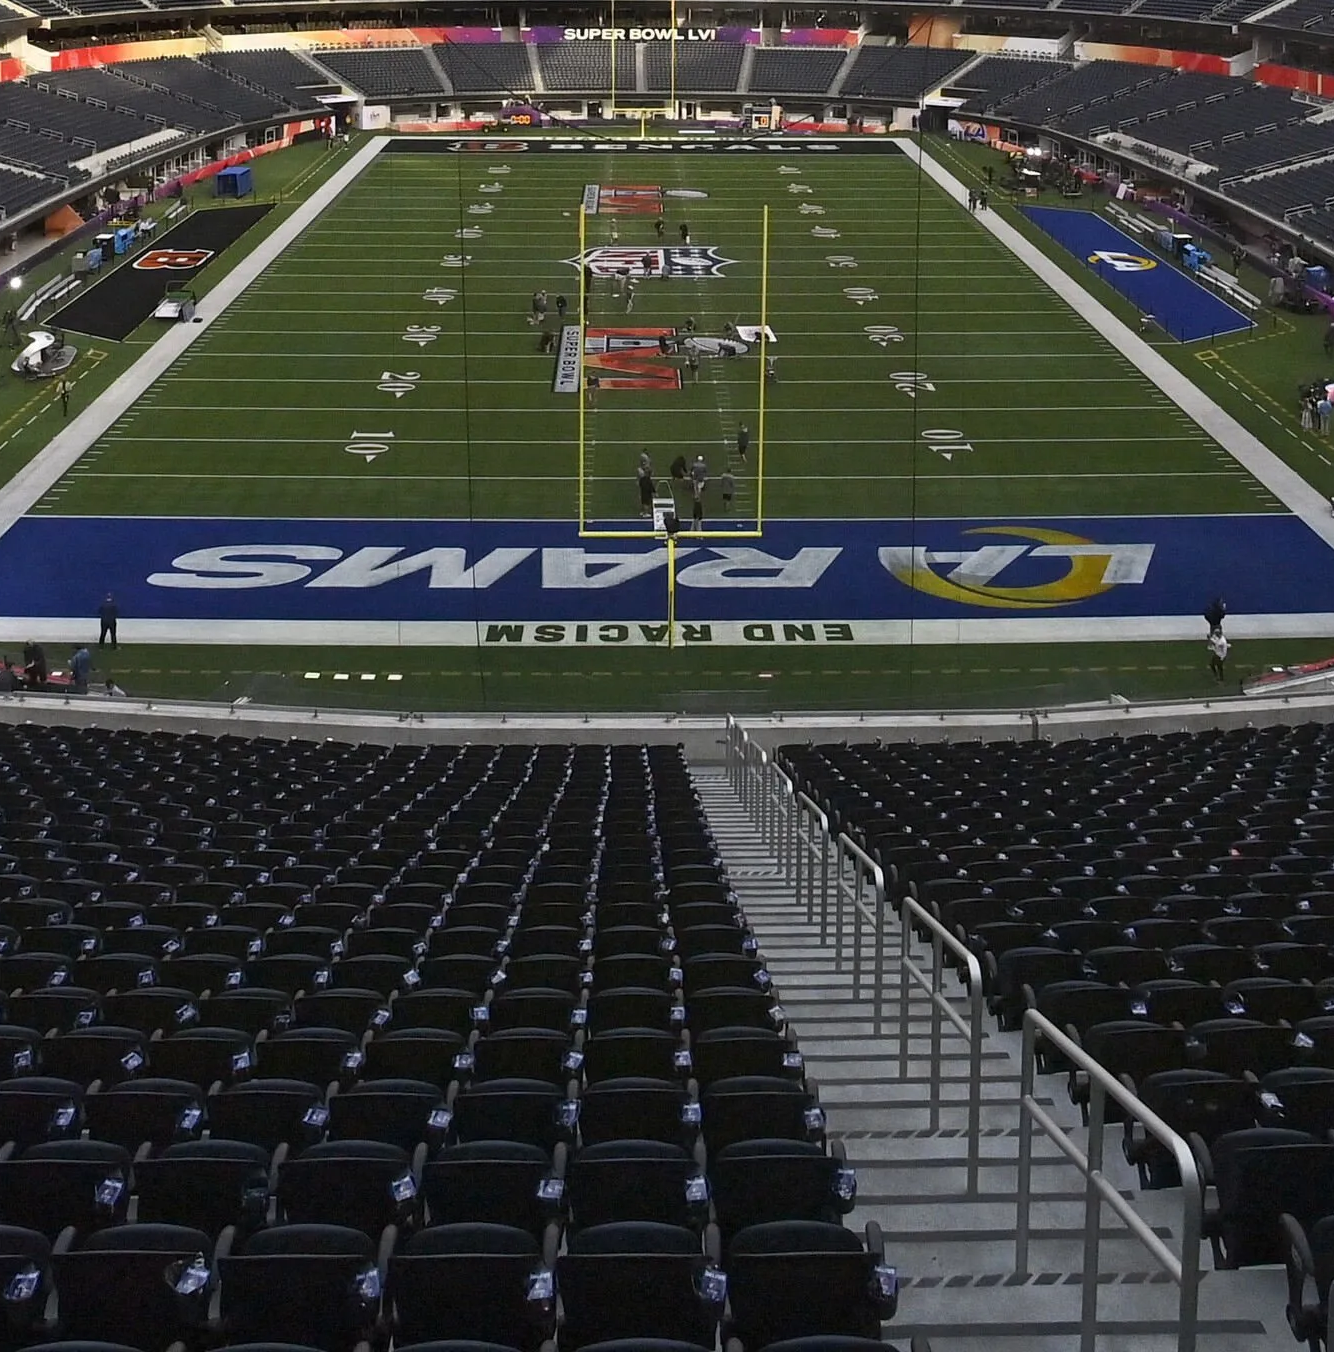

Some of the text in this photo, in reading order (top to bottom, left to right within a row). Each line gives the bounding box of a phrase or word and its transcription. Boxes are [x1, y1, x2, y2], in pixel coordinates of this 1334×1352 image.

[564, 28, 716, 41] SUPER BOWL LVI
[422, 287, 459, 301] 40
[842, 287, 879, 301] 40
[402, 325, 441, 341] 30
[864, 325, 904, 341] 30
[560, 330, 580, 385] SUPER BOWL
[377, 371, 421, 391] 20
[889, 372, 936, 391] 20
[345, 430, 395, 454] 10
[921, 429, 973, 452] 10
[147, 544, 843, 589] RAMS
[485, 624, 855, 642] END RACISM
